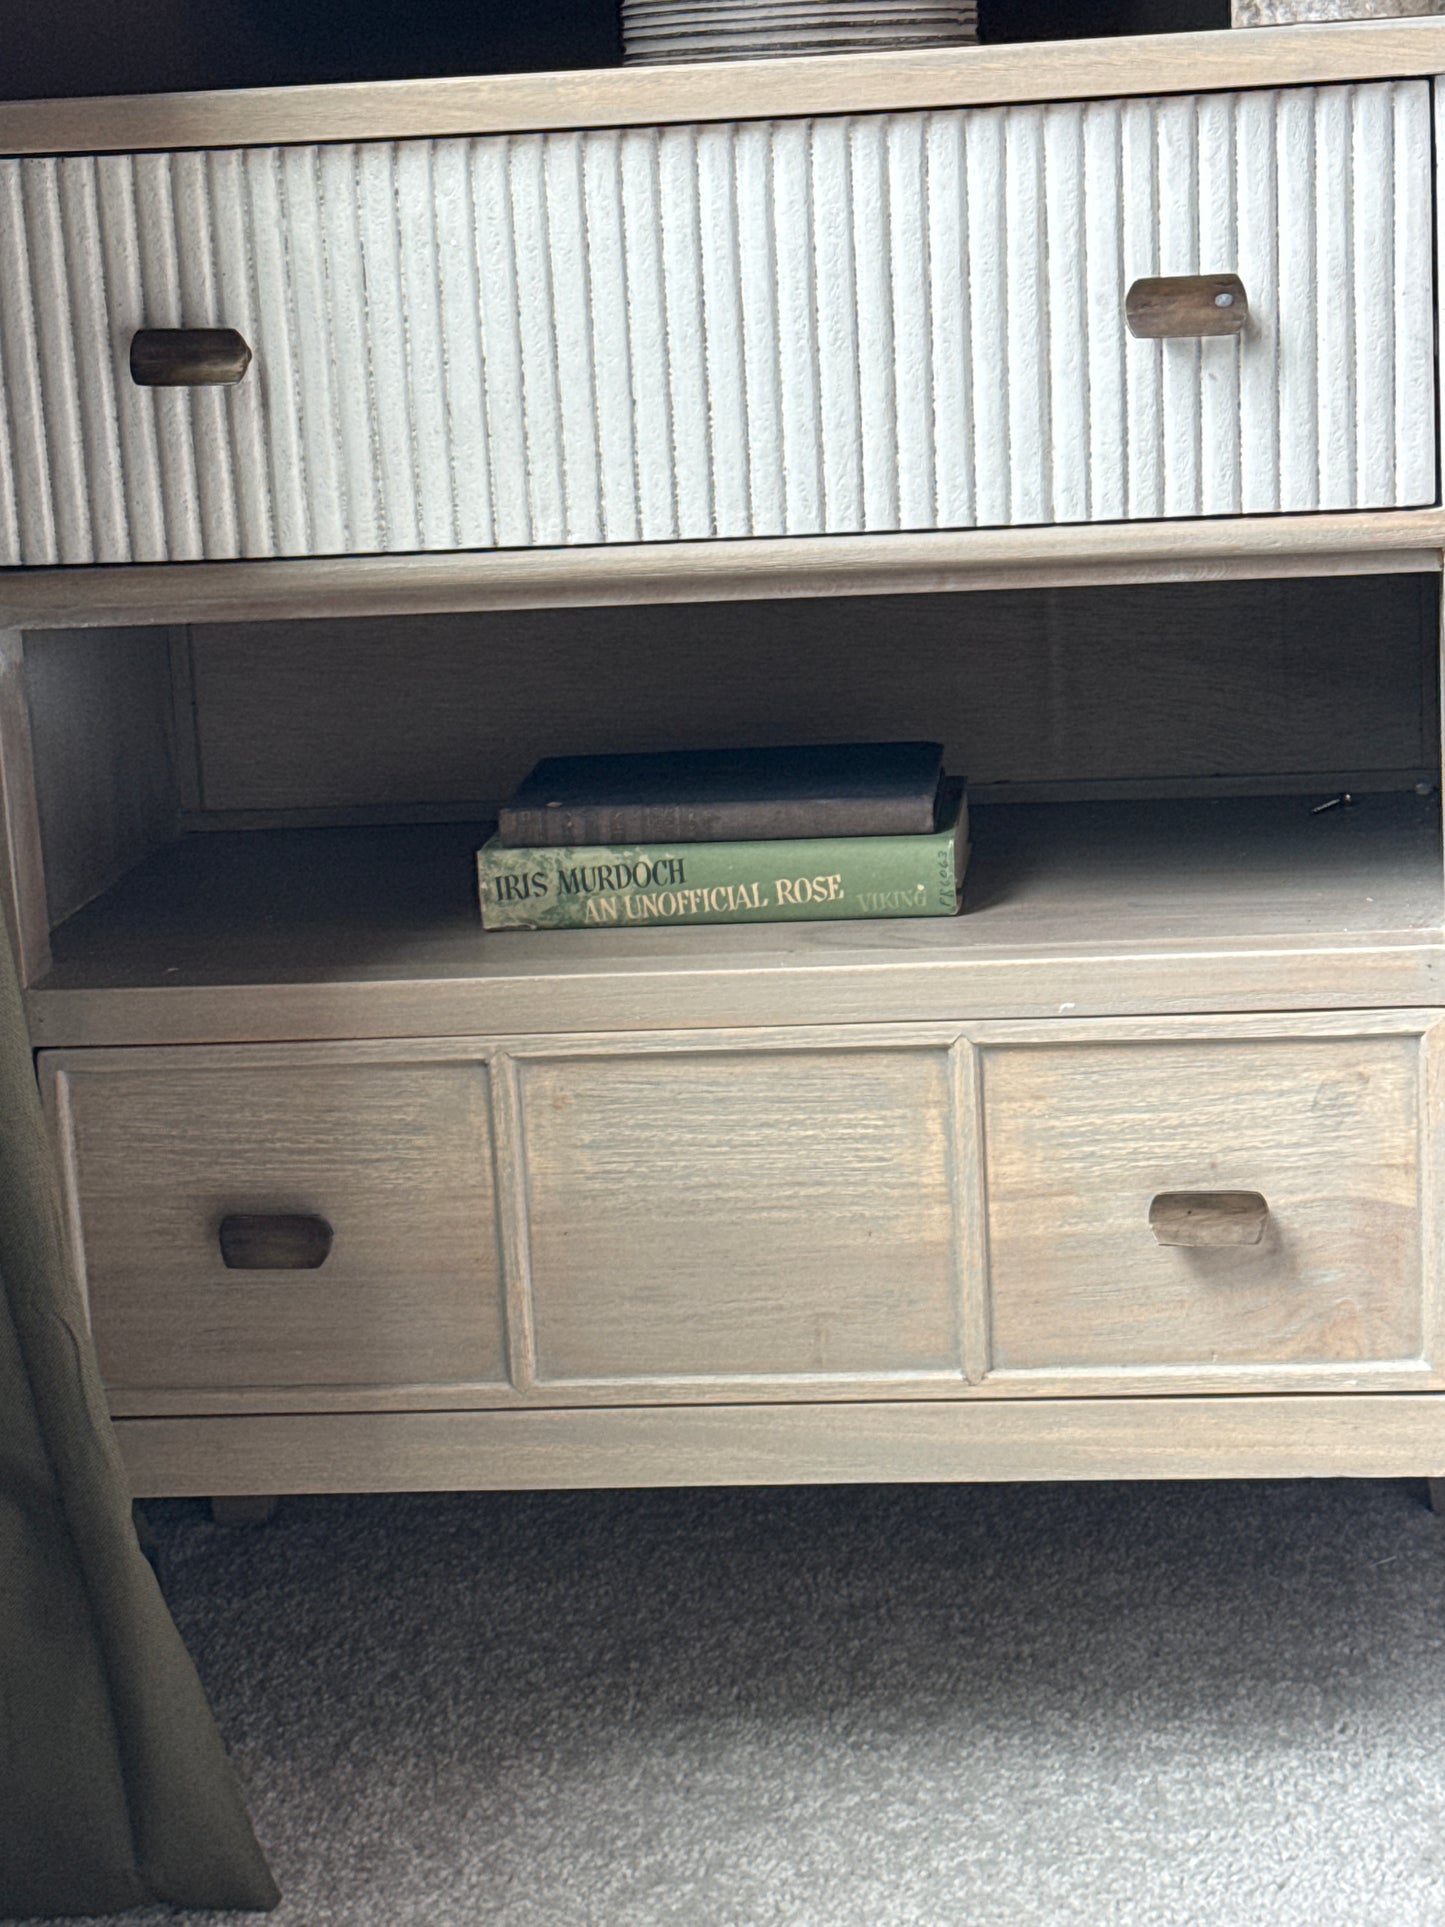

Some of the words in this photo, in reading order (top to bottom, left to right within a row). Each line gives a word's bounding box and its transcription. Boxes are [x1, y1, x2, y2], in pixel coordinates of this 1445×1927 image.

[495, 871, 548, 902] IRIS
[557, 857, 687, 896] MURDOCH
[584, 895, 620, 924] AN
[624, 882, 769, 921] UNOFFICIAL
[774, 873, 845, 906] ROSE
[855, 888, 928, 913] VIKING
